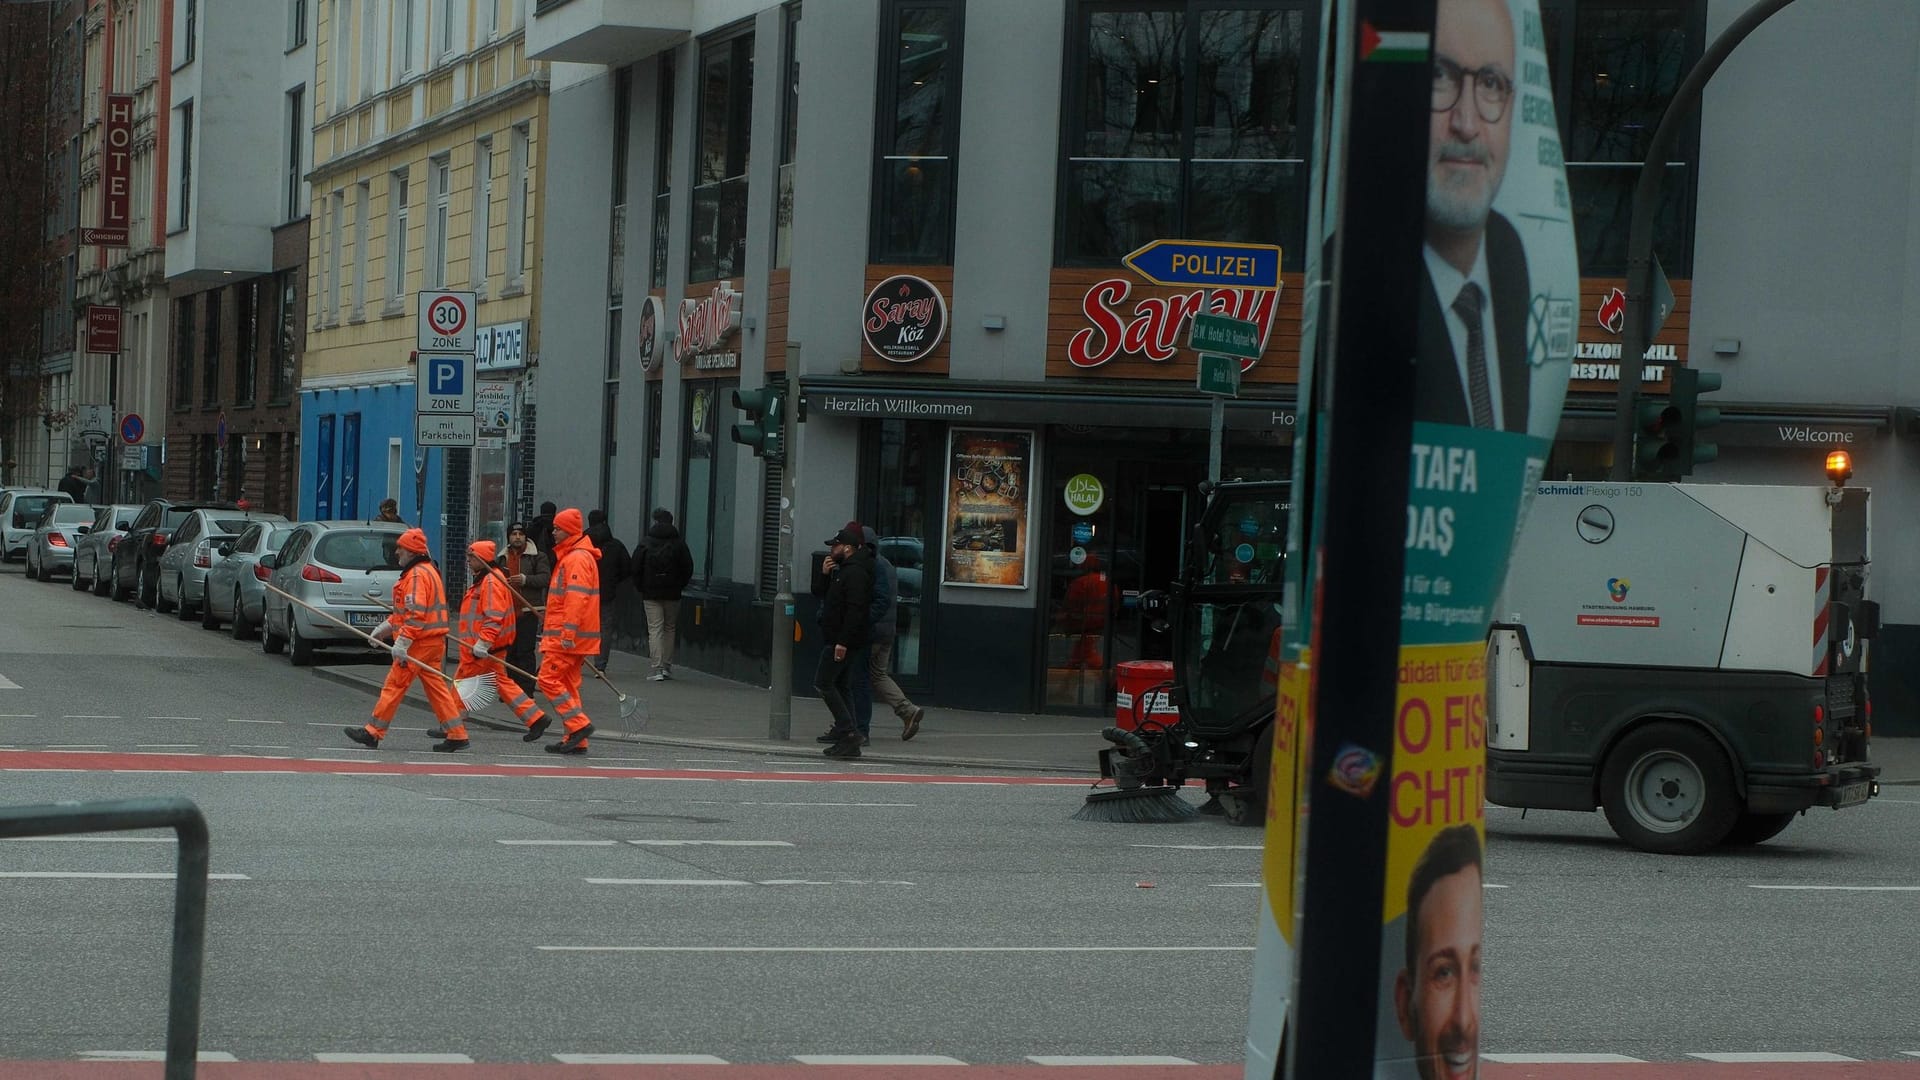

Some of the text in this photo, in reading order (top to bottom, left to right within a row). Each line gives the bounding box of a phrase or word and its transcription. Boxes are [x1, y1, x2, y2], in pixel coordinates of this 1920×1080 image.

[110, 103, 129, 220] HOTEL
[1171, 253, 1256, 277] POLIZEI
[92, 313, 117, 321] HOTEL
[435, 306, 459, 325] 30
[866, 296, 936, 333] Saray
[432, 337, 462, 348] ZONE
[897, 325, 924, 344] Köz
[1208, 326, 1225, 343] Hotel
[496, 328, 520, 362] PHONE
[437, 363, 455, 390] P
[431, 399, 461, 409] ZONE
[824, 397, 973, 415] Herzlich Willkommen
[439, 421, 454, 430] mit
[421, 430, 471, 440] Parkschein
[1778, 426, 1854, 443] Welcome
[1070, 492, 1097, 503] HALAL
[1538, 485, 1643, 499] schmidt Flexigo 150
